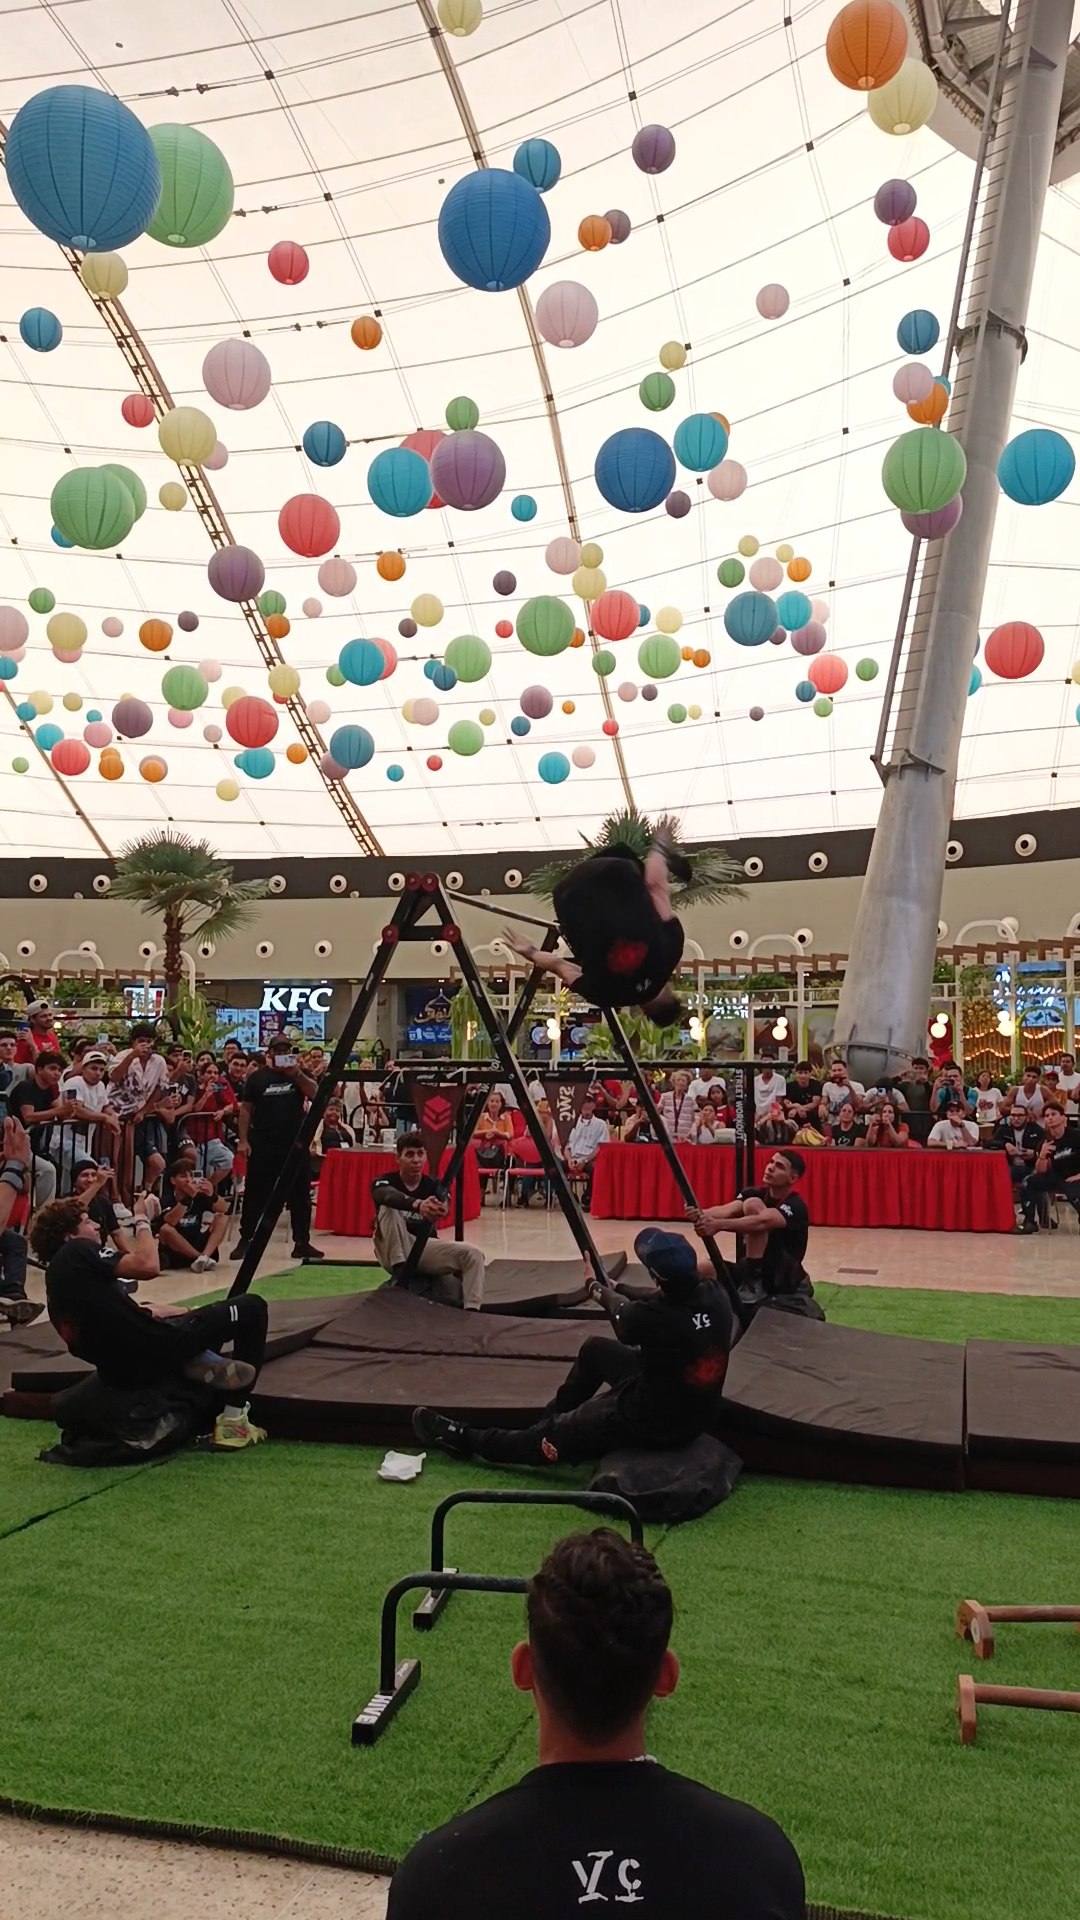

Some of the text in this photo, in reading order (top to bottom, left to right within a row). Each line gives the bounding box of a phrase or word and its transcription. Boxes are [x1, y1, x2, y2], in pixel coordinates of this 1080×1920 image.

[259, 987, 333, 1012] KFC
[736, 1068, 744, 1140] STREET WORKOUT
[355, 1693, 394, 1725] HIVE
